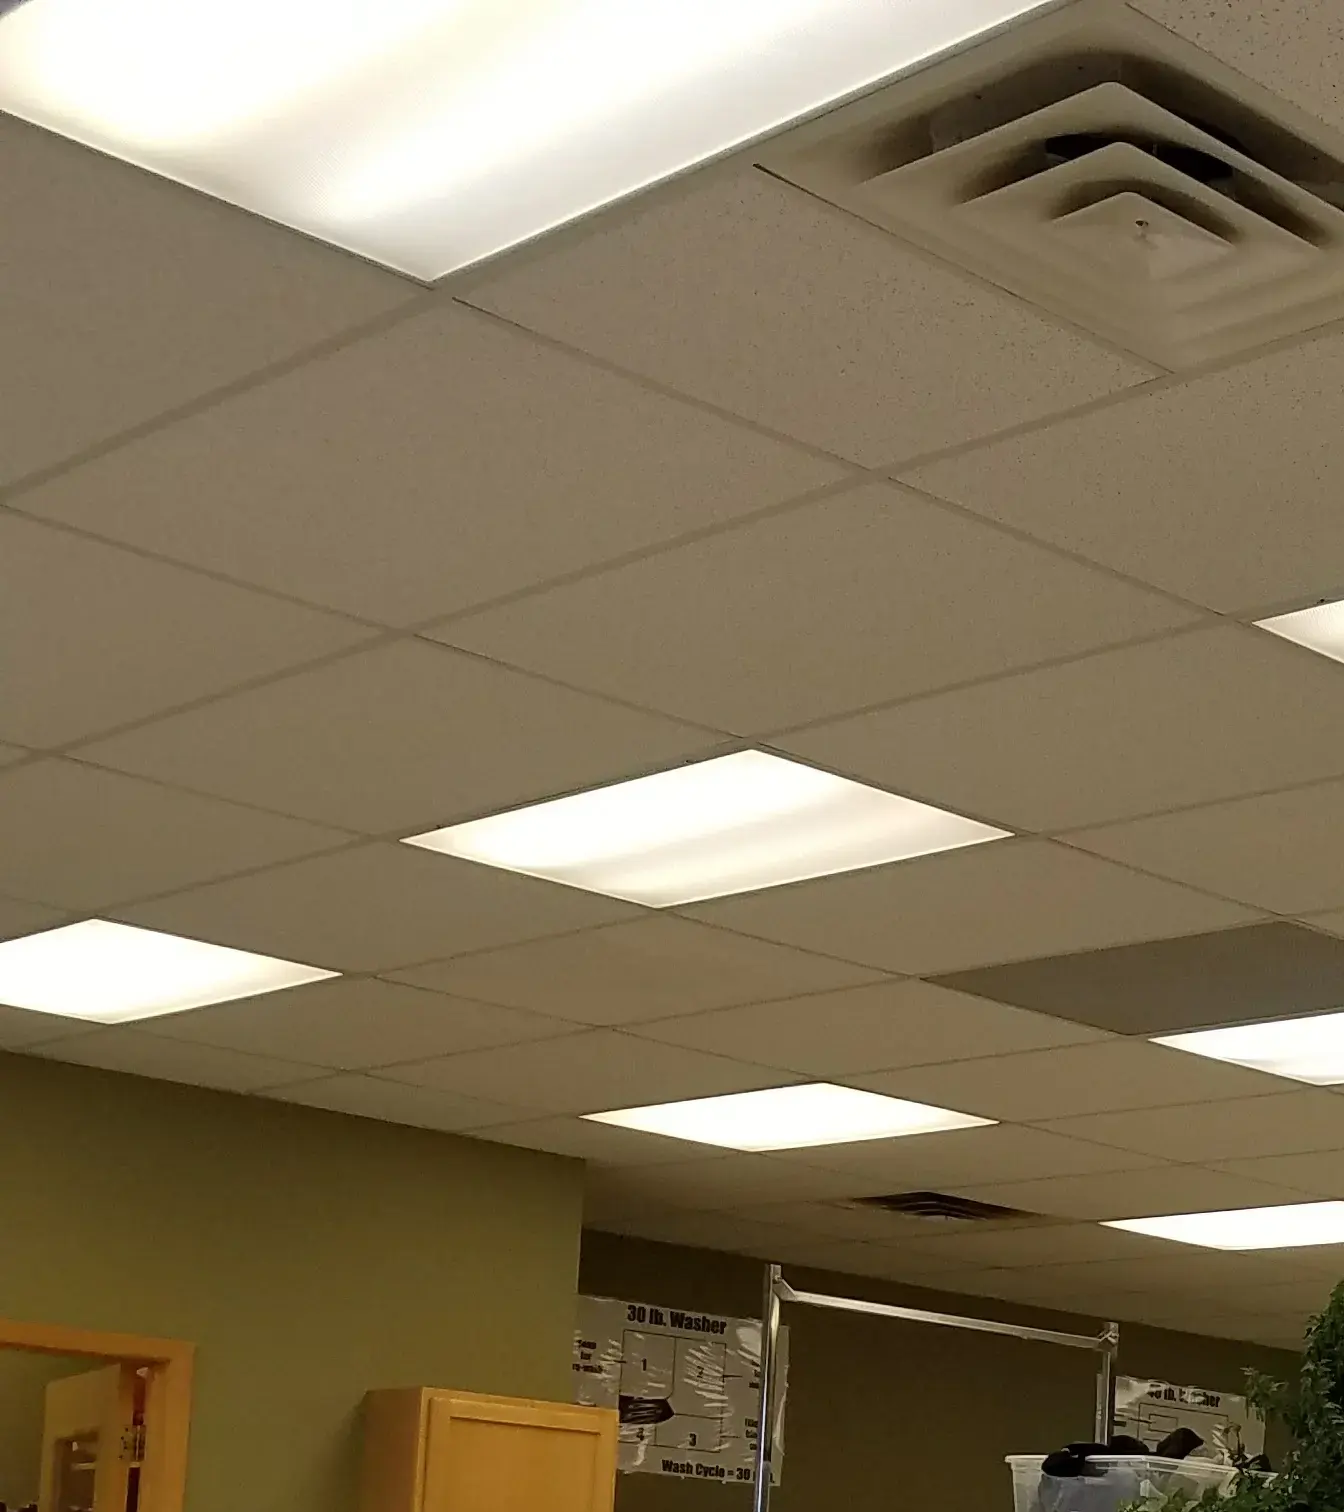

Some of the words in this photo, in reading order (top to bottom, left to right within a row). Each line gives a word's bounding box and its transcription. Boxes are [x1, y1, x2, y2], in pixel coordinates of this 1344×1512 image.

[627, 1305, 646, 1322] 30
[649, 1308, 667, 1327] lb.
[669, 1311, 727, 1335] Washer
[642, 1358, 648, 1372] 1
[689, 1433, 697, 1447] 3
[662, 1459, 693, 1474] Wash
[695, 1464, 725, 1479] Cycle
[736, 1467, 751, 1480] 30
